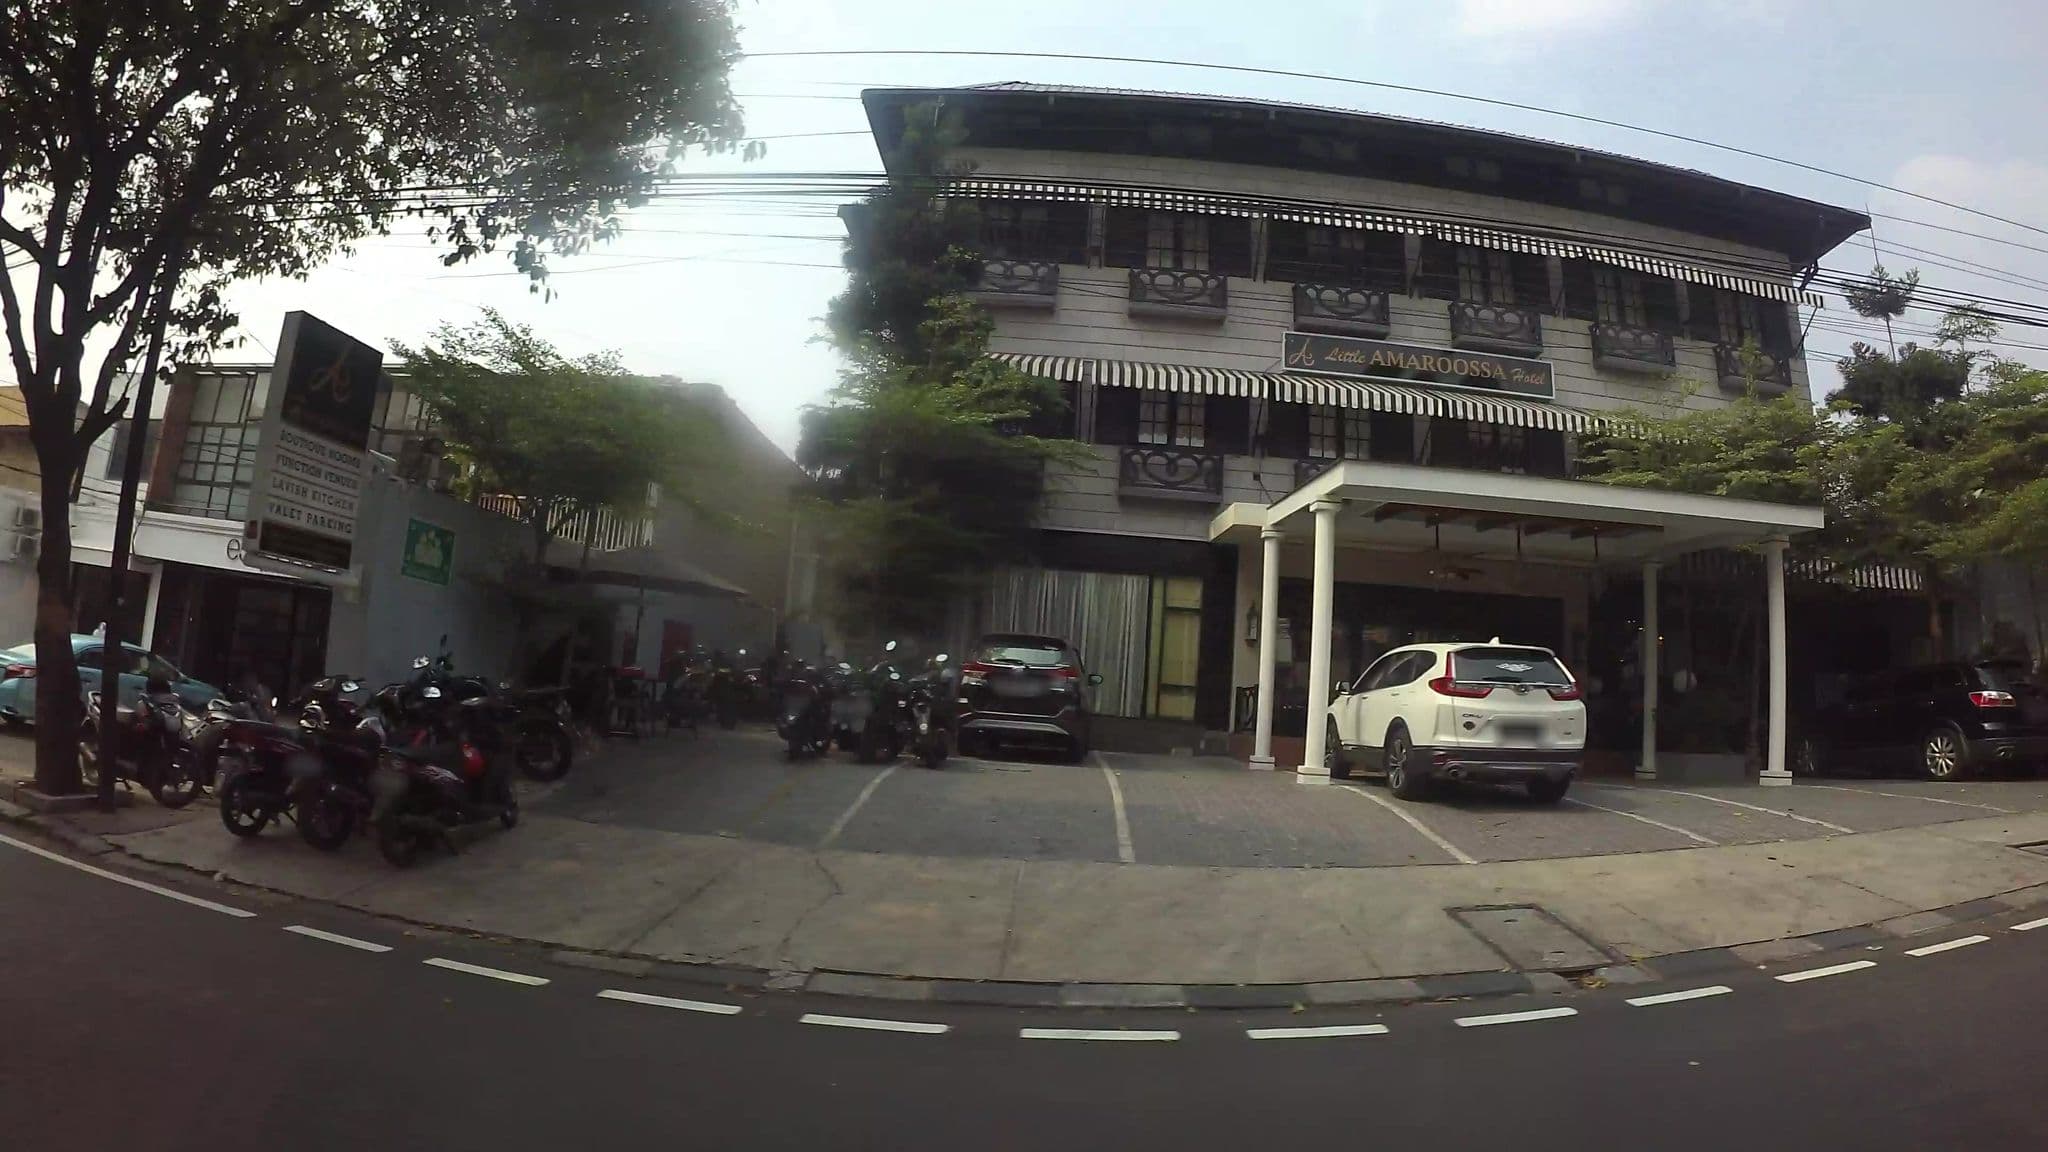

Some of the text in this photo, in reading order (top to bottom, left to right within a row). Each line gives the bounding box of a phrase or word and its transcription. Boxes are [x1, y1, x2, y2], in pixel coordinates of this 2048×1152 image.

[1324, 348, 1546, 385] Little AMAROOSSA Hotel
[277, 454, 322, 478] FUNCTION
[272, 477, 354, 512] LAVISH KITCHEN
[268, 502, 353, 534] VALET PARKING
